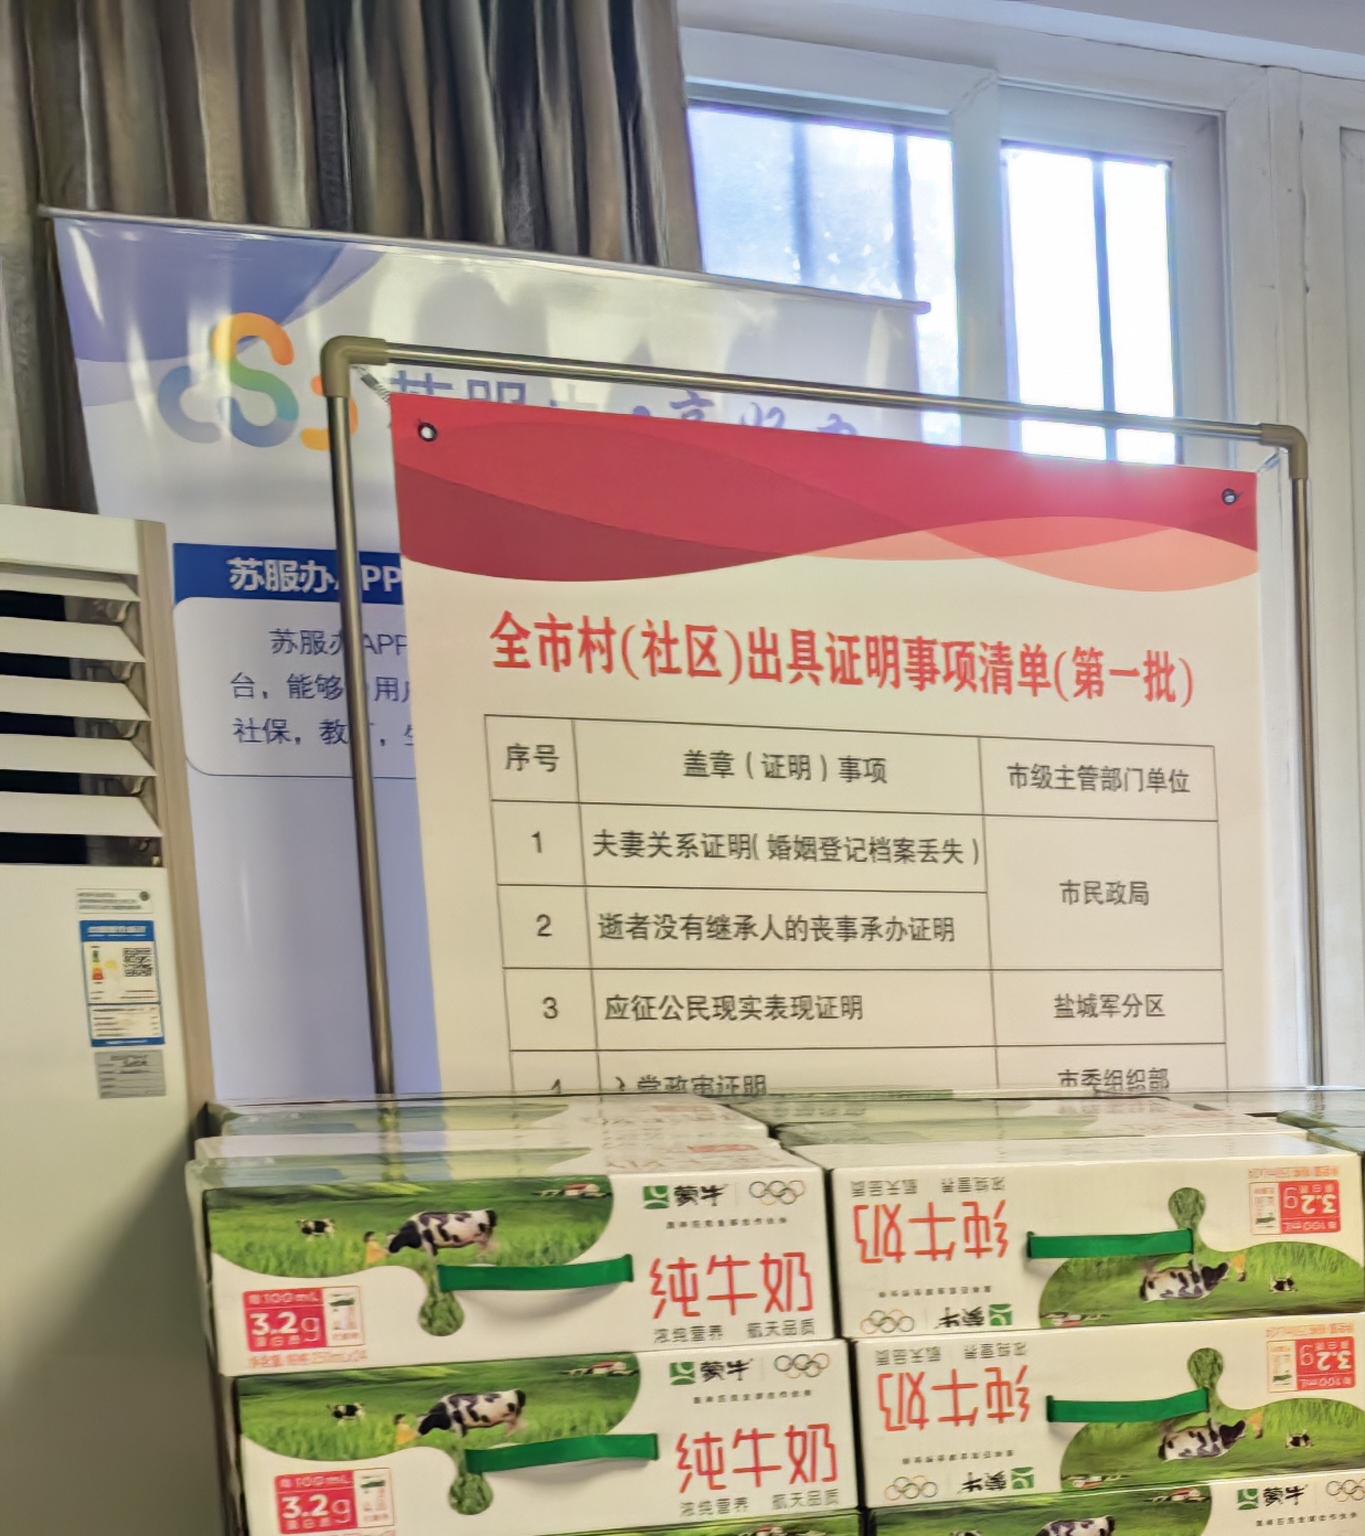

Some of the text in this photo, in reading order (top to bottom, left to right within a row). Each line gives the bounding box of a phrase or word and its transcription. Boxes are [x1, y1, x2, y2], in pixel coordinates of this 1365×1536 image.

[226, 557, 402, 593] 苏服办PP
[490, 610, 1194, 707] 全市村(社区)出具证明事项清单(第一批)
[505, 743, 559, 773] 序号
[1007, 762, 1191, 794] 市级主管部门单位
[531, 832, 543, 854] 1
[1059, 879, 1150, 906] 市民政局
[536, 914, 553, 937] 2
[597, 913, 956, 943] 逝者没有继承人的丧事承办证明
[542, 997, 559, 1020] 3
[604, 993, 864, 1022] 应征公民现实表现证明
[1053, 993, 1166, 1019] 盐城军分区
[1057, 1067, 1170, 1093] 市委组织部
[674, 1185, 723, 1206] 蒙牛
[853, 1201, 1009, 1265] 纯牛奶
[650, 1252, 814, 1319] 纯牛奶
[250, 1311, 321, 1342] 3.2g
[701, 1360, 749, 1381] 蒙牛
[878, 1366, 1031, 1432] 纯牛奶
[676, 1423, 838, 1493] 纯牛奶
[281, 1493, 352, 1527] 3.2g
[1263, 1486, 1304, 1506] 蒙牛
